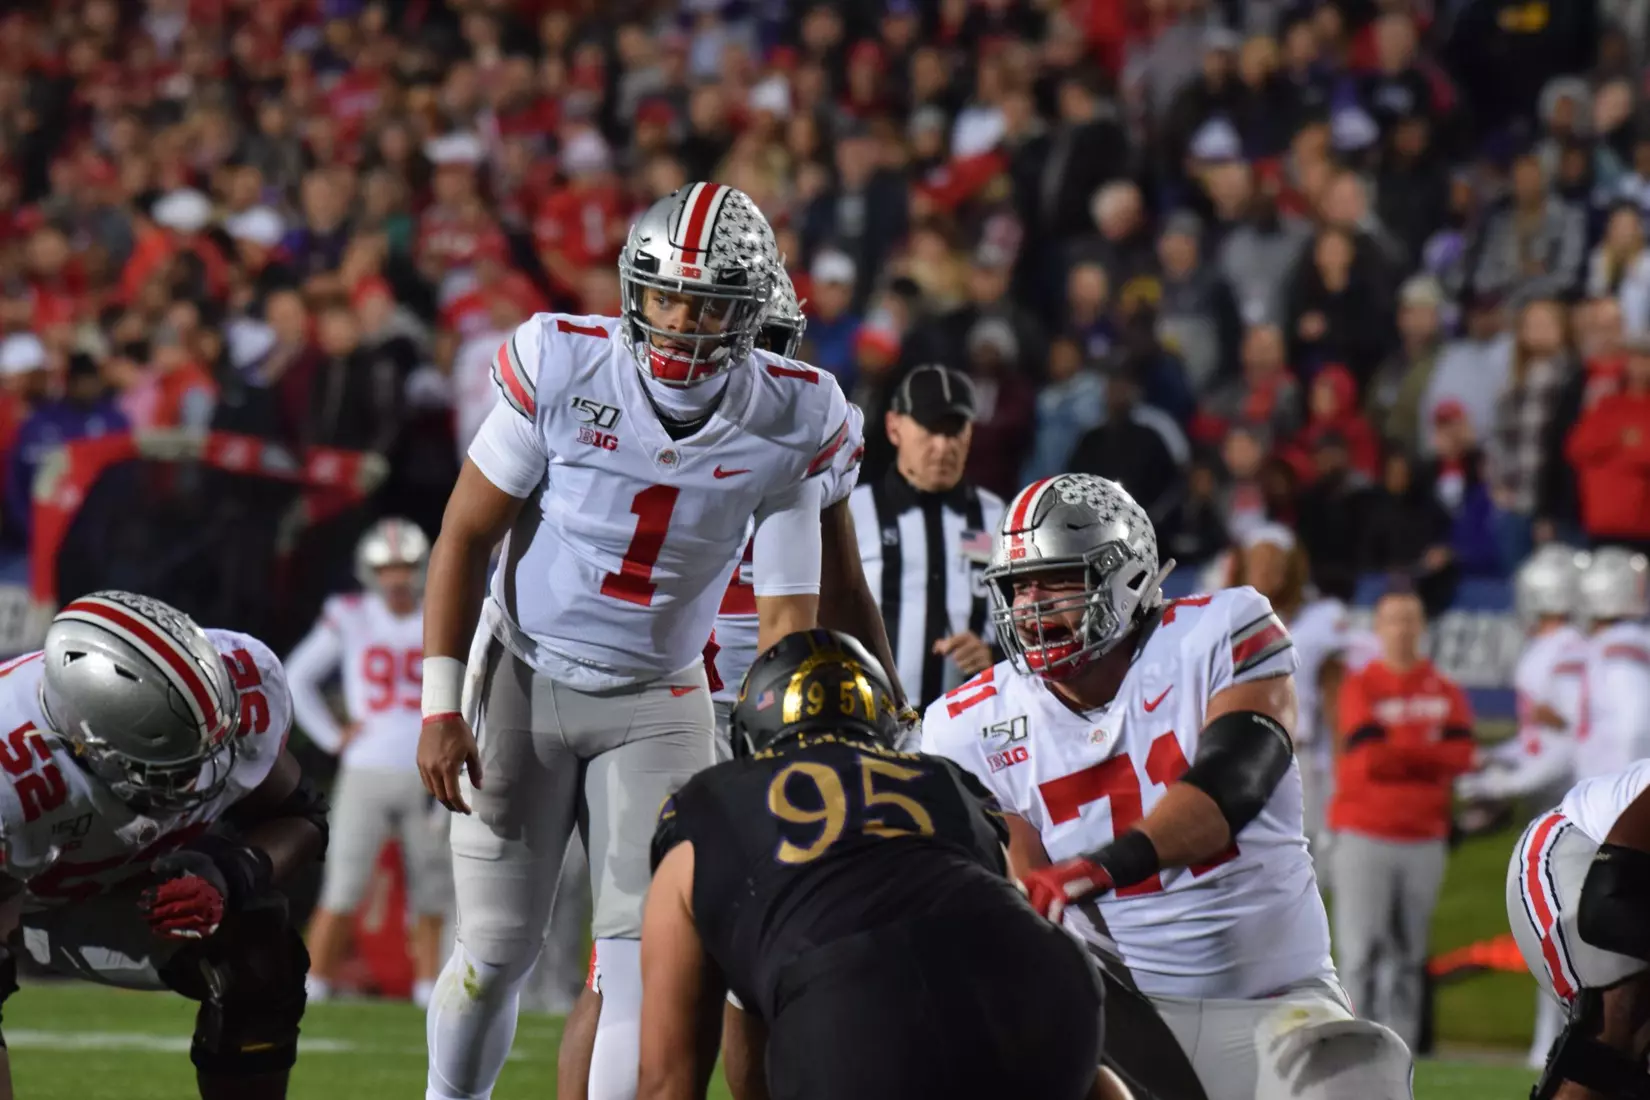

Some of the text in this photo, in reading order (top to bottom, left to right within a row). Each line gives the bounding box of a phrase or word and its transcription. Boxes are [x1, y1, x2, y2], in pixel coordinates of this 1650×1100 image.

[557, 319, 609, 339] 1
[767, 364, 819, 385] 1
[571, 397, 621, 429] 150
[600, 484, 680, 607] 1
[982, 715, 1028, 750] 150
[0, 720, 68, 822] 52
[767, 755, 937, 865] 95
